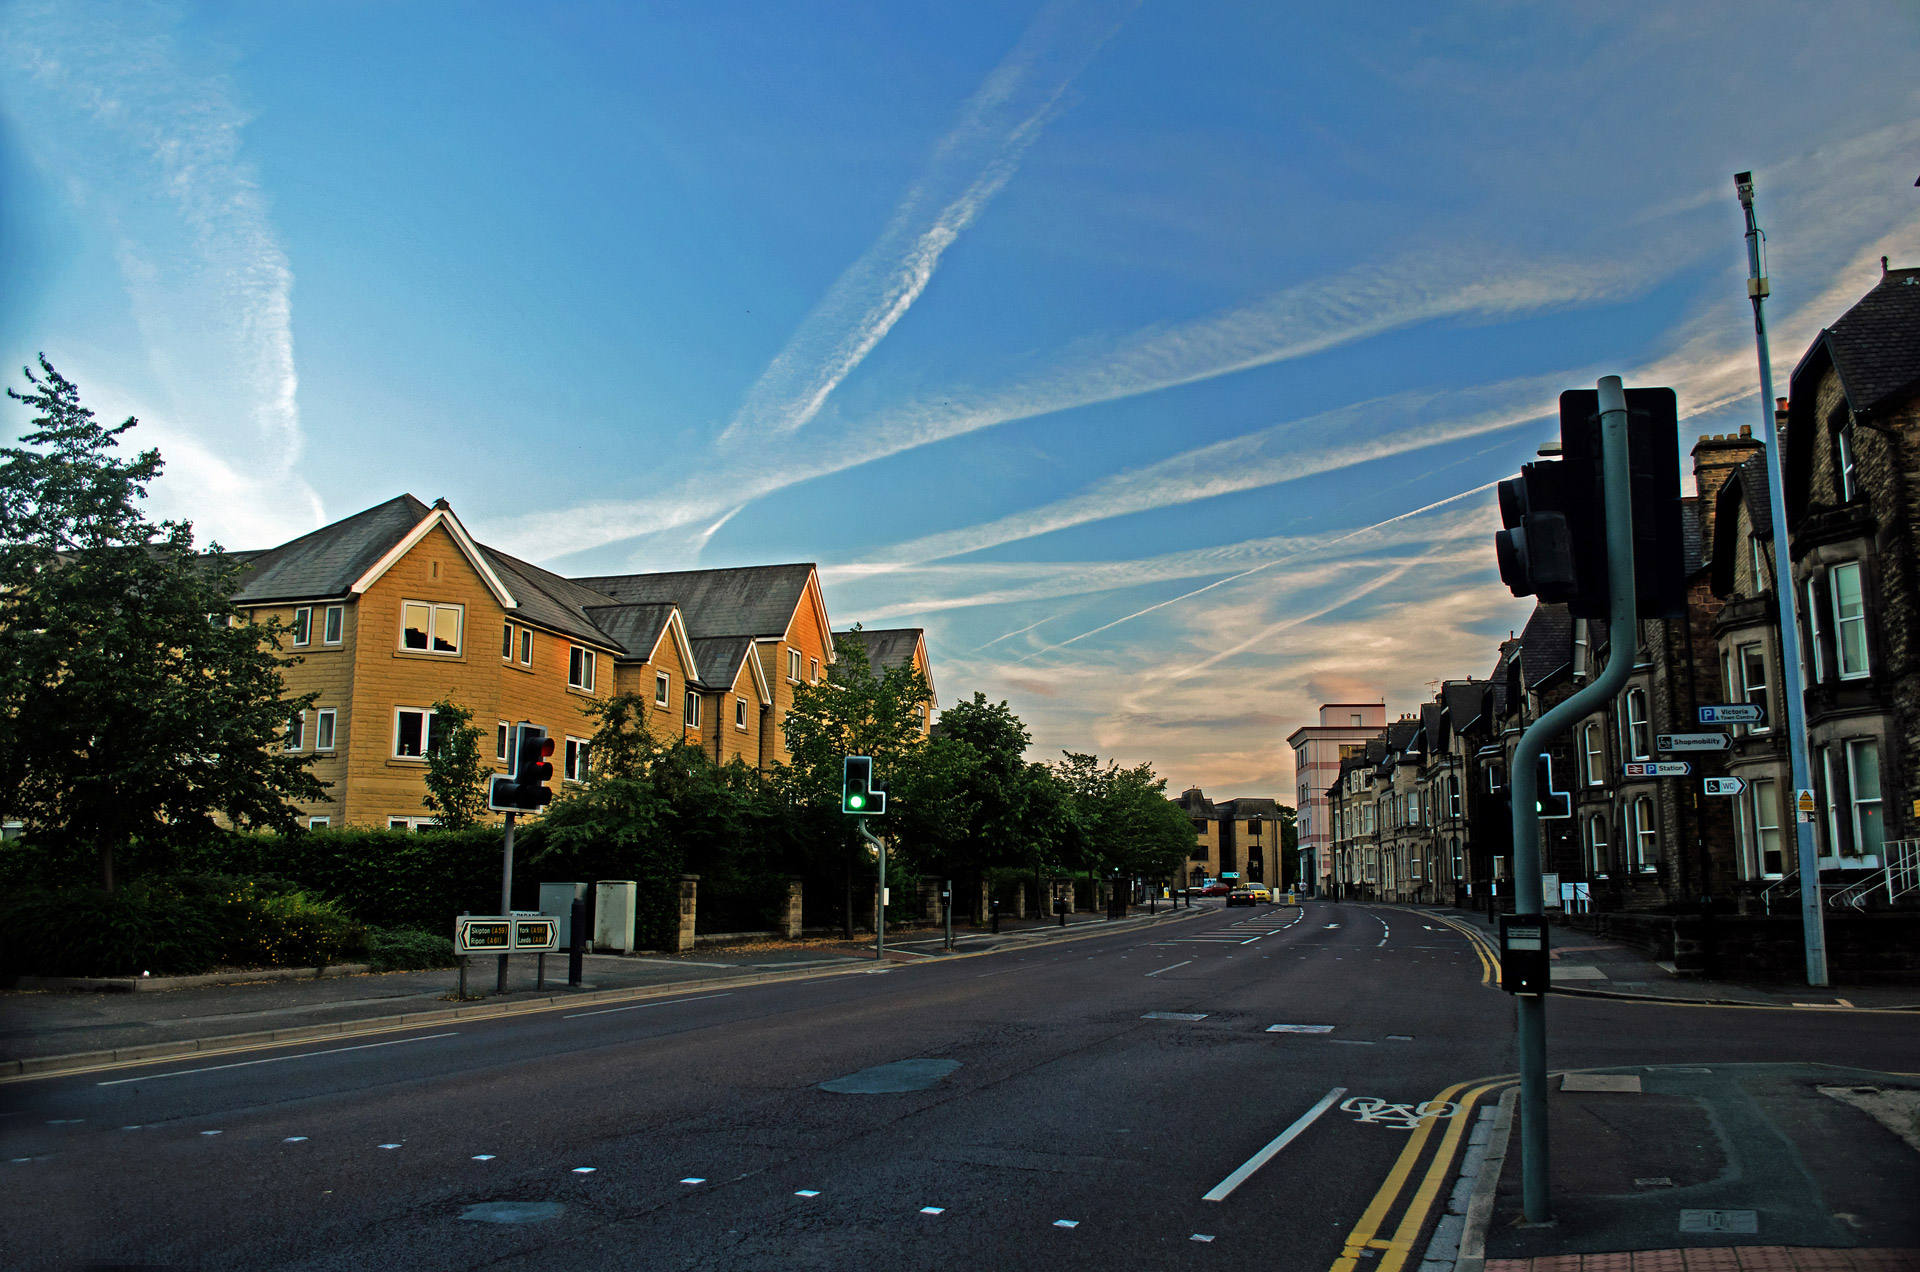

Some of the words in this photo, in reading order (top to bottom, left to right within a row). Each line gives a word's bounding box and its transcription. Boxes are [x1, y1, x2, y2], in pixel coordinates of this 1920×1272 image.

[1674, 738, 1720, 746] Shopmobility
[471, 926, 490, 935] Skipton
[492, 926, 508, 934] (A59)
[530, 926, 545, 934] (A59)
[470, 937, 486, 945] Ripon
[486, 936, 502, 944] (A61)
[532, 936, 546, 944] (A61)
